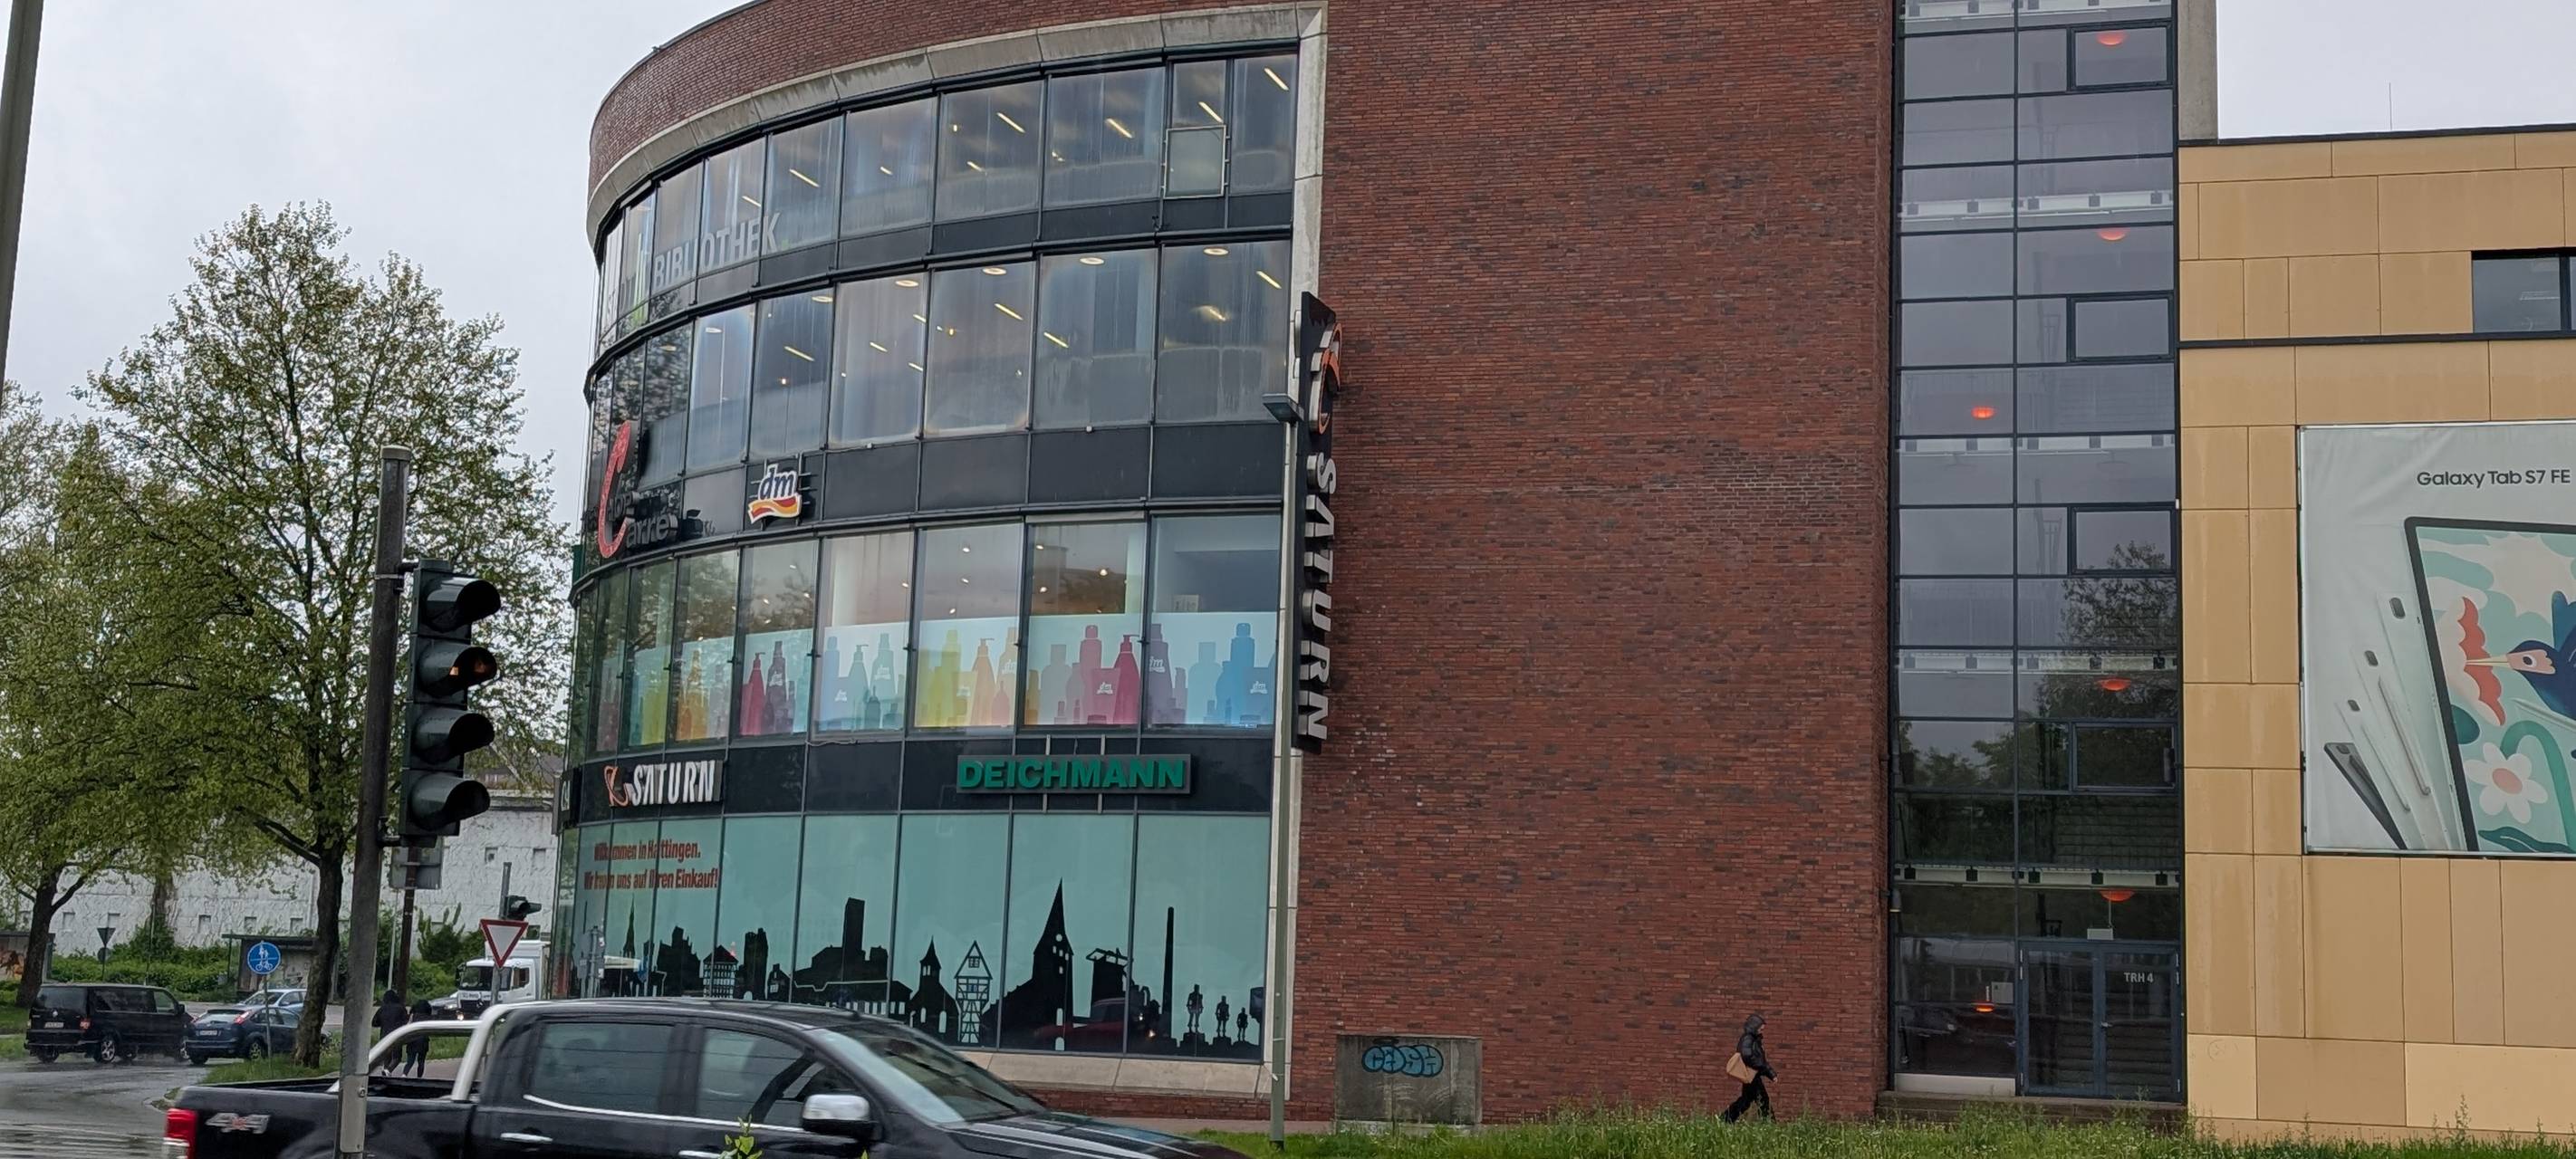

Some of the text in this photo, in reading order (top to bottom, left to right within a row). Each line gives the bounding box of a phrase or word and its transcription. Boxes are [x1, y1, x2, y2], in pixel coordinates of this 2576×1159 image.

[653, 212, 781, 292] BIBLIOTHEK
[2417, 469, 2571, 489] Galaxy Tab S7 FE
[1302, 452, 1337, 740] SATURN
[632, 760, 716, 806] SATURN
[958, 759, 1187, 790] DEICHMANN
[676, 867, 718, 889] Einkauf!
[2124, 972, 2154, 983] TRH 4
